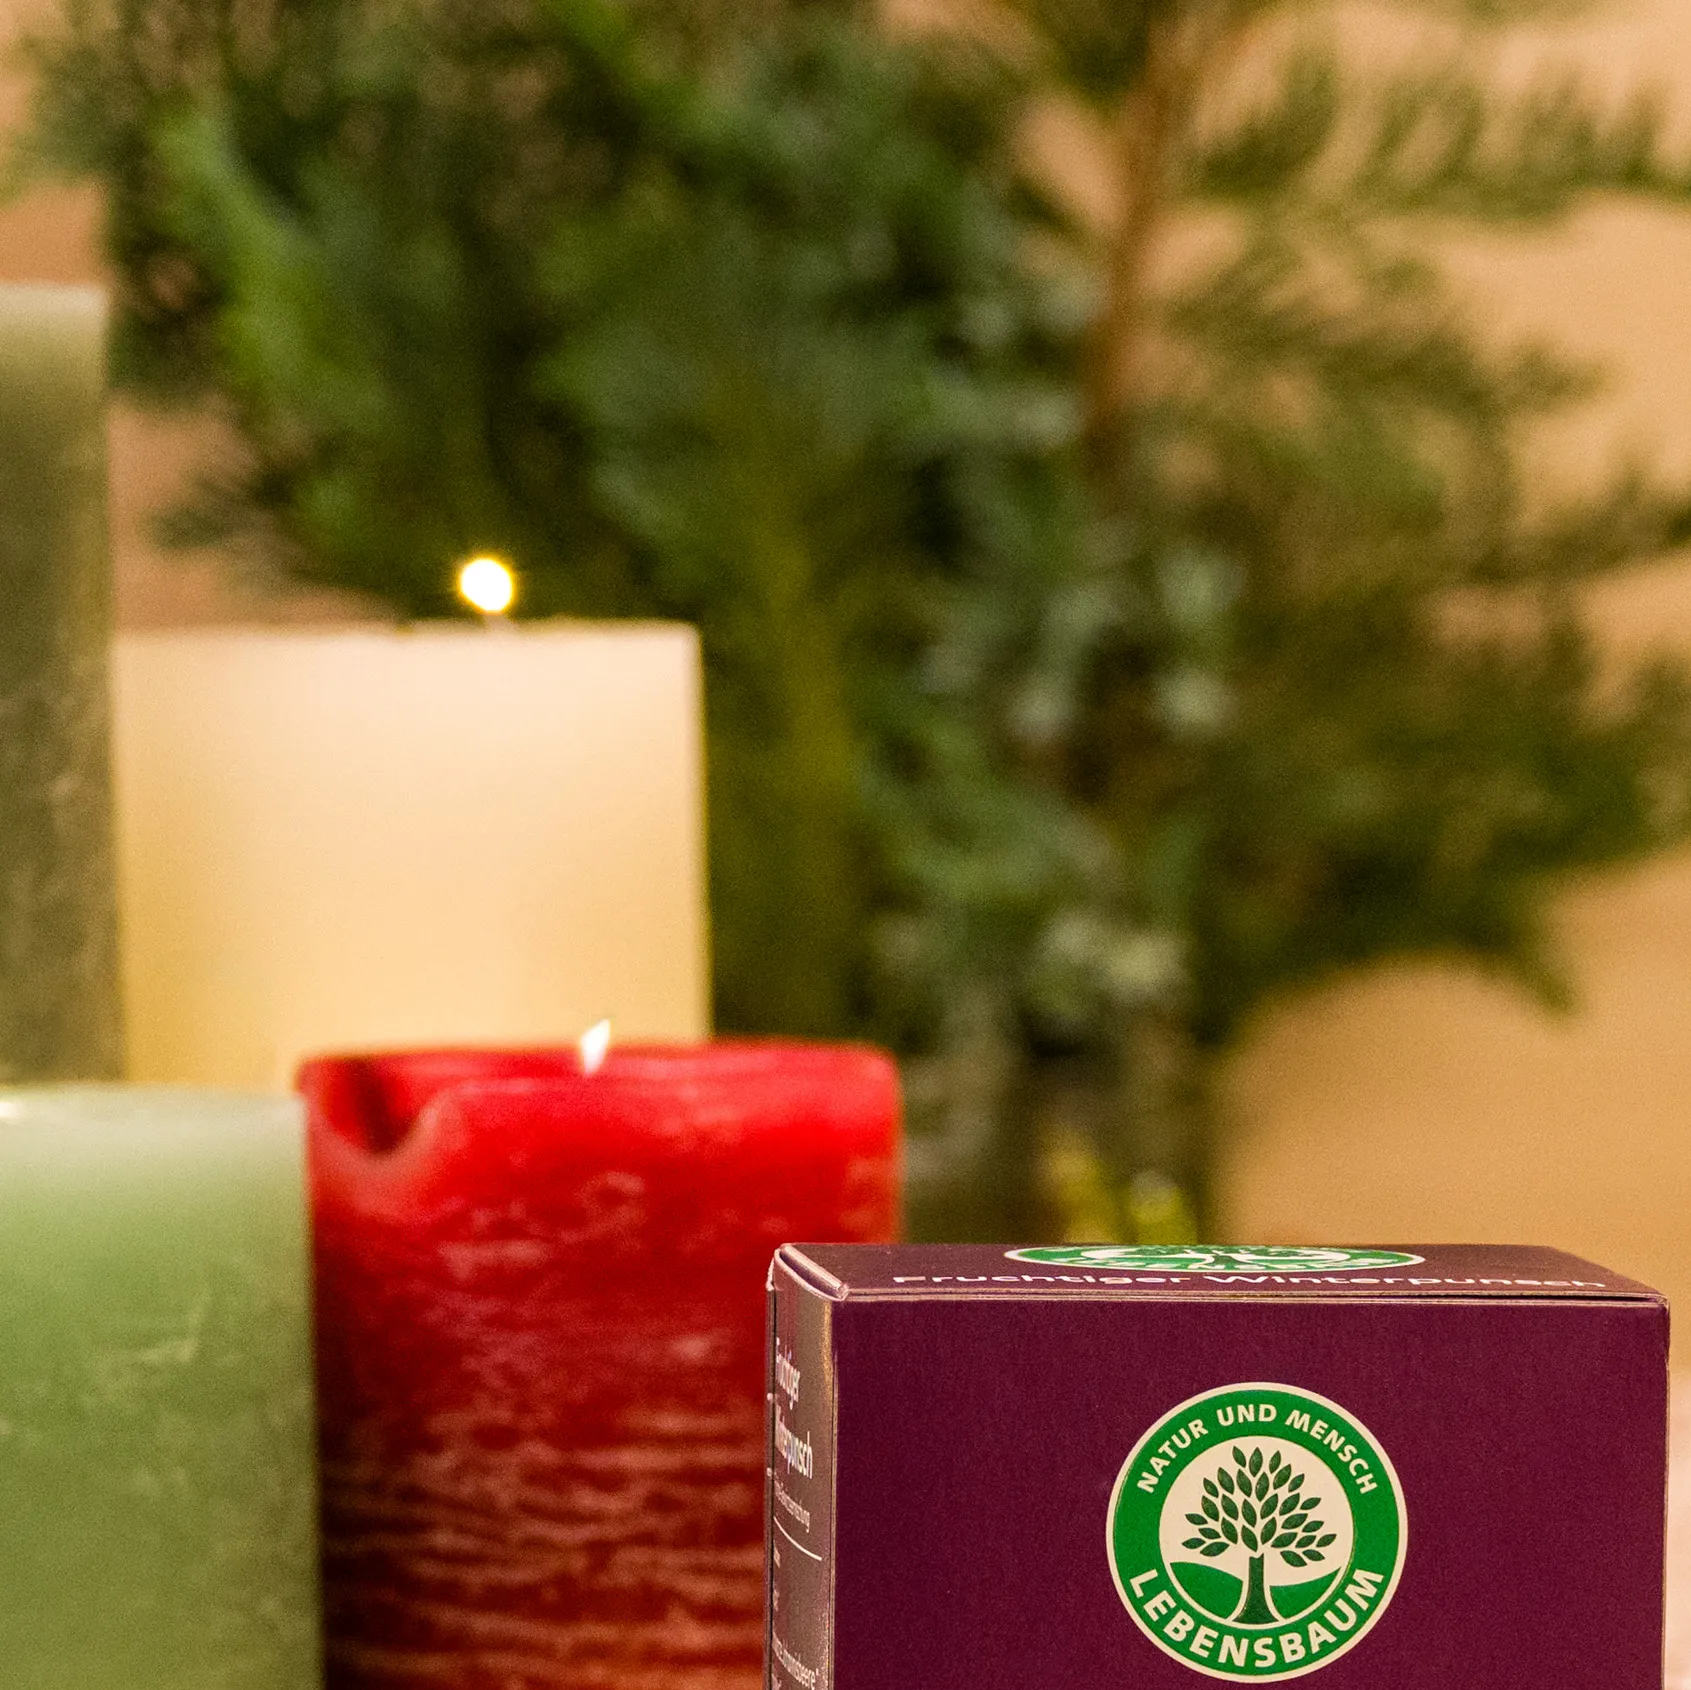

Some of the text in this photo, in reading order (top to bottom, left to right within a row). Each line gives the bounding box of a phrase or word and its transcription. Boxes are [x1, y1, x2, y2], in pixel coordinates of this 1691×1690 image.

[1137, 1403, 1378, 1494] NATUR UND MENSCH
[1129, 1569, 1384, 1668] LEBENSBAUM
